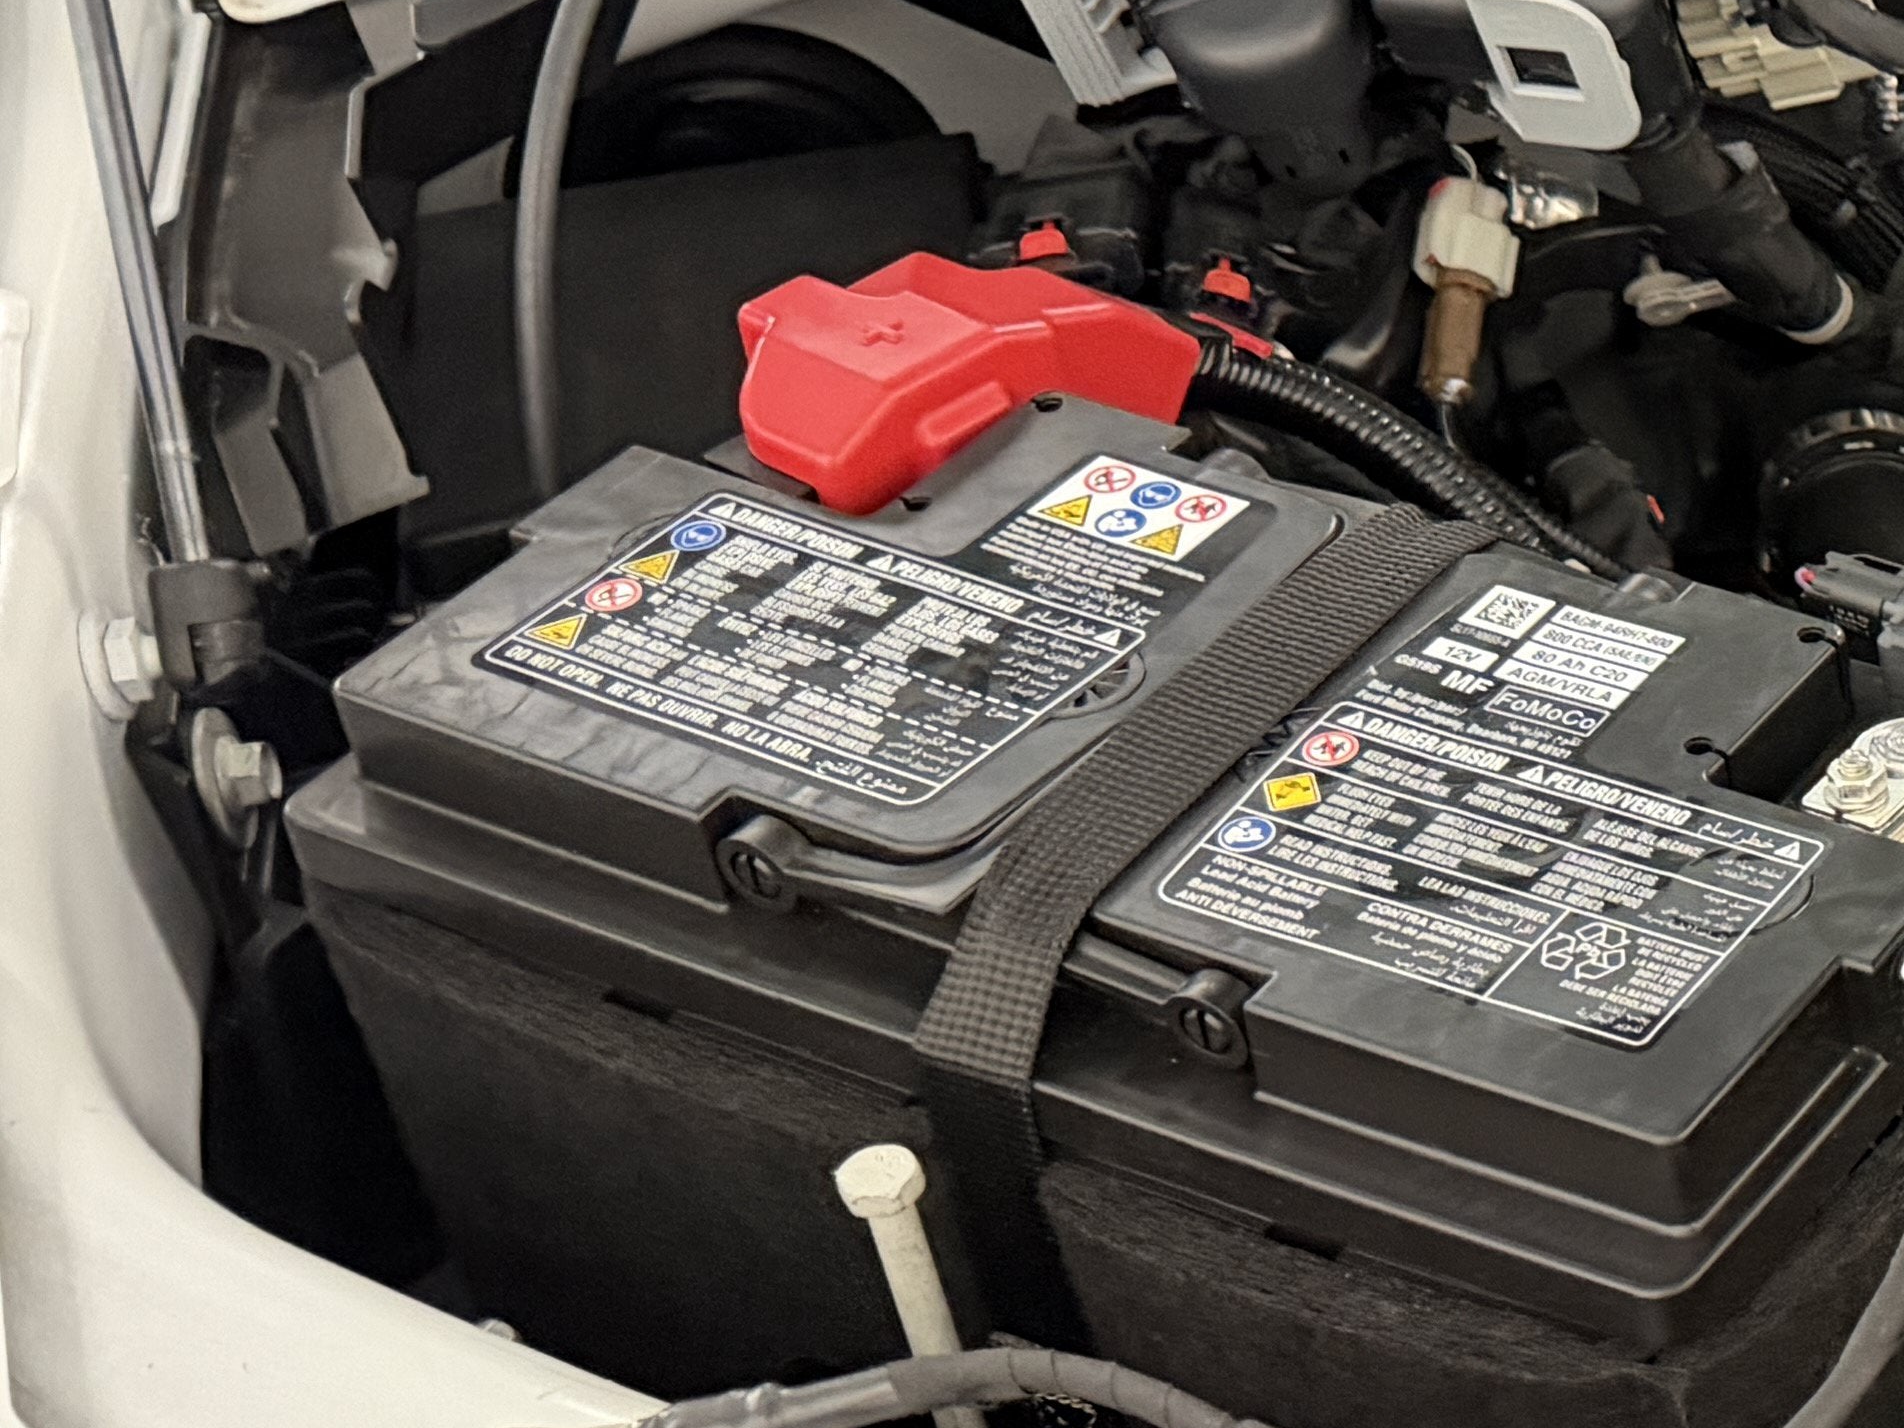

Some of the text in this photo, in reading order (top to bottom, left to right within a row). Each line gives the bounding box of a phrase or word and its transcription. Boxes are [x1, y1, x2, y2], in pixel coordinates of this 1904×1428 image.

[732, 508, 861, 558] DANGER/POISON
[890, 561, 1023, 612] PELIGRO/VENENO
[1444, 645, 1481, 662] 12V
[1542, 629, 1573, 644] 800
[1571, 637, 1603, 652] CCA
[504, 644, 603, 688] DO NOT OPEN.
[1440, 669, 1493, 693] MF
[1507, 667, 1611, 702] AGM/VRLA
[1531, 650, 1628, 682] 80 Ah C20
[605, 681, 717, 727] NE PAS OUVRIR.
[1492, 689, 1595, 729] FoMoCo
[721, 720, 811, 762] NO LA ABRA.
[1363, 718, 1508, 770] DANGER/POISON
[1544, 771, 1690, 824] PELIGRO/VENENO
[1279, 834, 1313, 851] READ
[1582, 829, 1601, 842] DE
[1597, 833, 1621, 848] LOS
[1200, 864, 1238, 882] Lead
[1212, 854, 1326, 896] NON-SPILLABLE
[1417, 875, 1443, 890] LEA
[1439, 882, 1465, 897] LAS
[1174, 889, 1212, 906] ANTI
[1367, 902, 1512, 953] CONTRA DERRAMES
